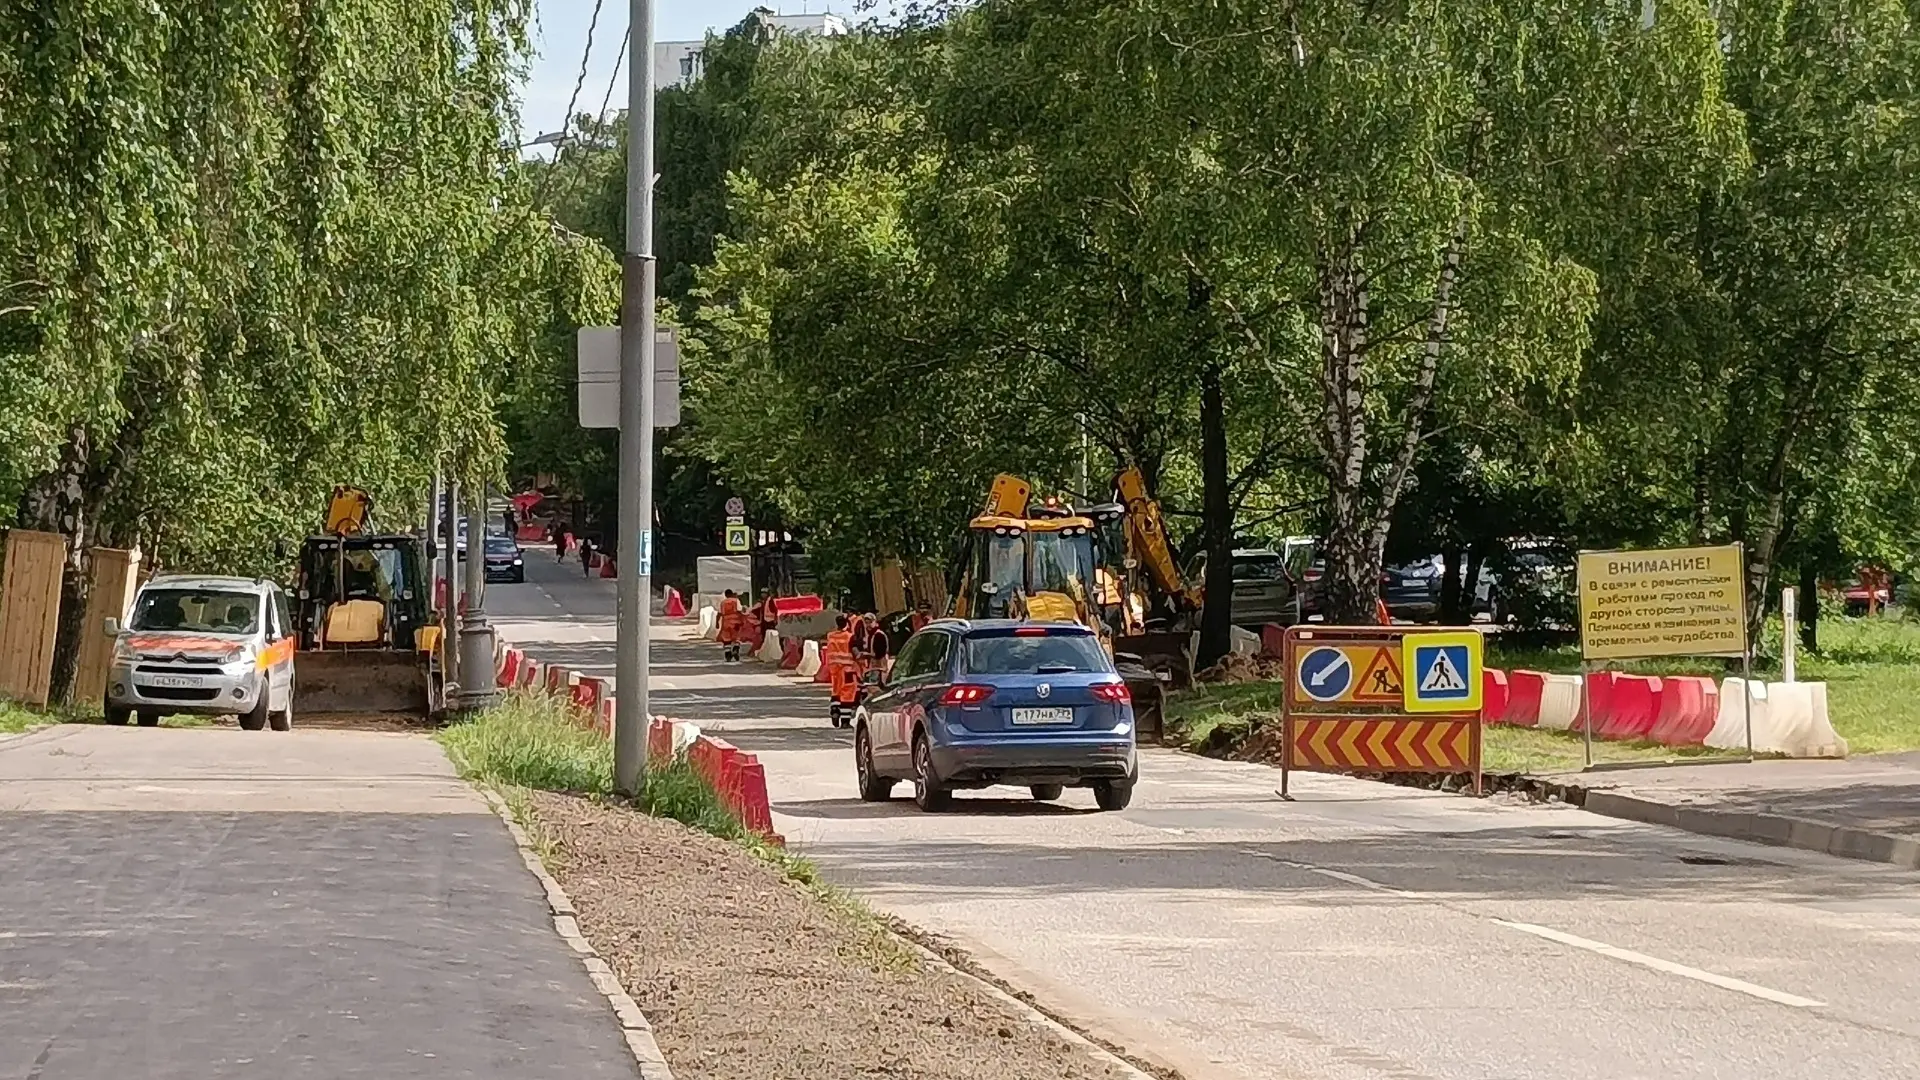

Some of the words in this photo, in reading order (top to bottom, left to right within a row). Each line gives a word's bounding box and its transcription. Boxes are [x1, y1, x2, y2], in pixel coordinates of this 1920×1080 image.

[1608, 557, 1711, 575] ВНИМАНИЕ!
[1589, 580, 1598, 591] В
[1597, 593, 1657, 607] работами
[1709, 590, 1724, 598] по
[1589, 607, 1632, 620] другой
